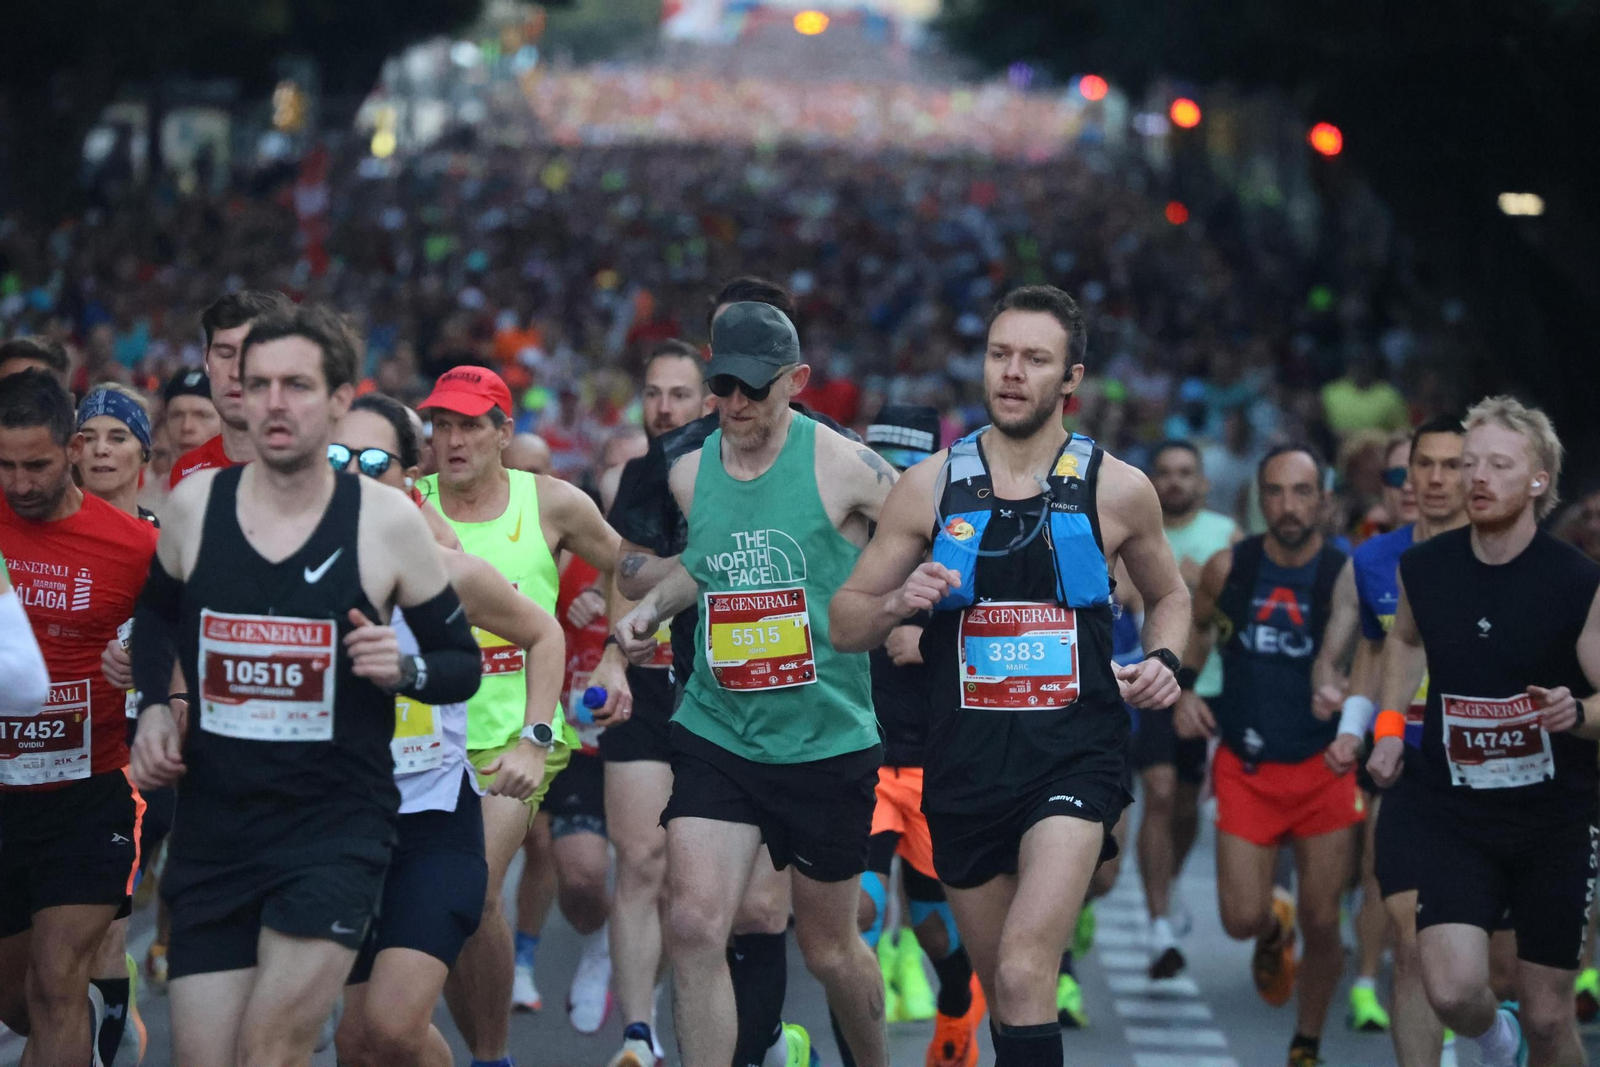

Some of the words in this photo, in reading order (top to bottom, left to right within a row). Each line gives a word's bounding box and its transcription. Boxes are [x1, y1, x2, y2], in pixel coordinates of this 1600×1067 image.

[1050, 502, 1078, 511] EVADICT
[731, 530, 767, 549] THE
[706, 548, 769, 572] NORTH
[727, 567, 772, 587] FACE
[15, 583, 67, 611] ÁLAGA
[730, 594, 798, 611] GENERALI
[988, 608, 1066, 624] GENERALI
[231, 622, 323, 644] GENERALI
[732, 626, 780, 646] 5515
[988, 642, 1045, 661] 3383
[222, 659, 303, 687] 10516
[778, 662, 798, 671] 42K
[47, 687, 80, 703] RALI
[1039, 683, 1061, 692] 42K
[1466, 699, 1532, 717] GENERALI
[0, 720, 66, 740] 17452
[18, 741, 45, 749] OVIDIU
[1463, 730, 1526, 749] 14742
[403, 745, 423, 754] 21K
[54, 757, 73, 766] 21K
